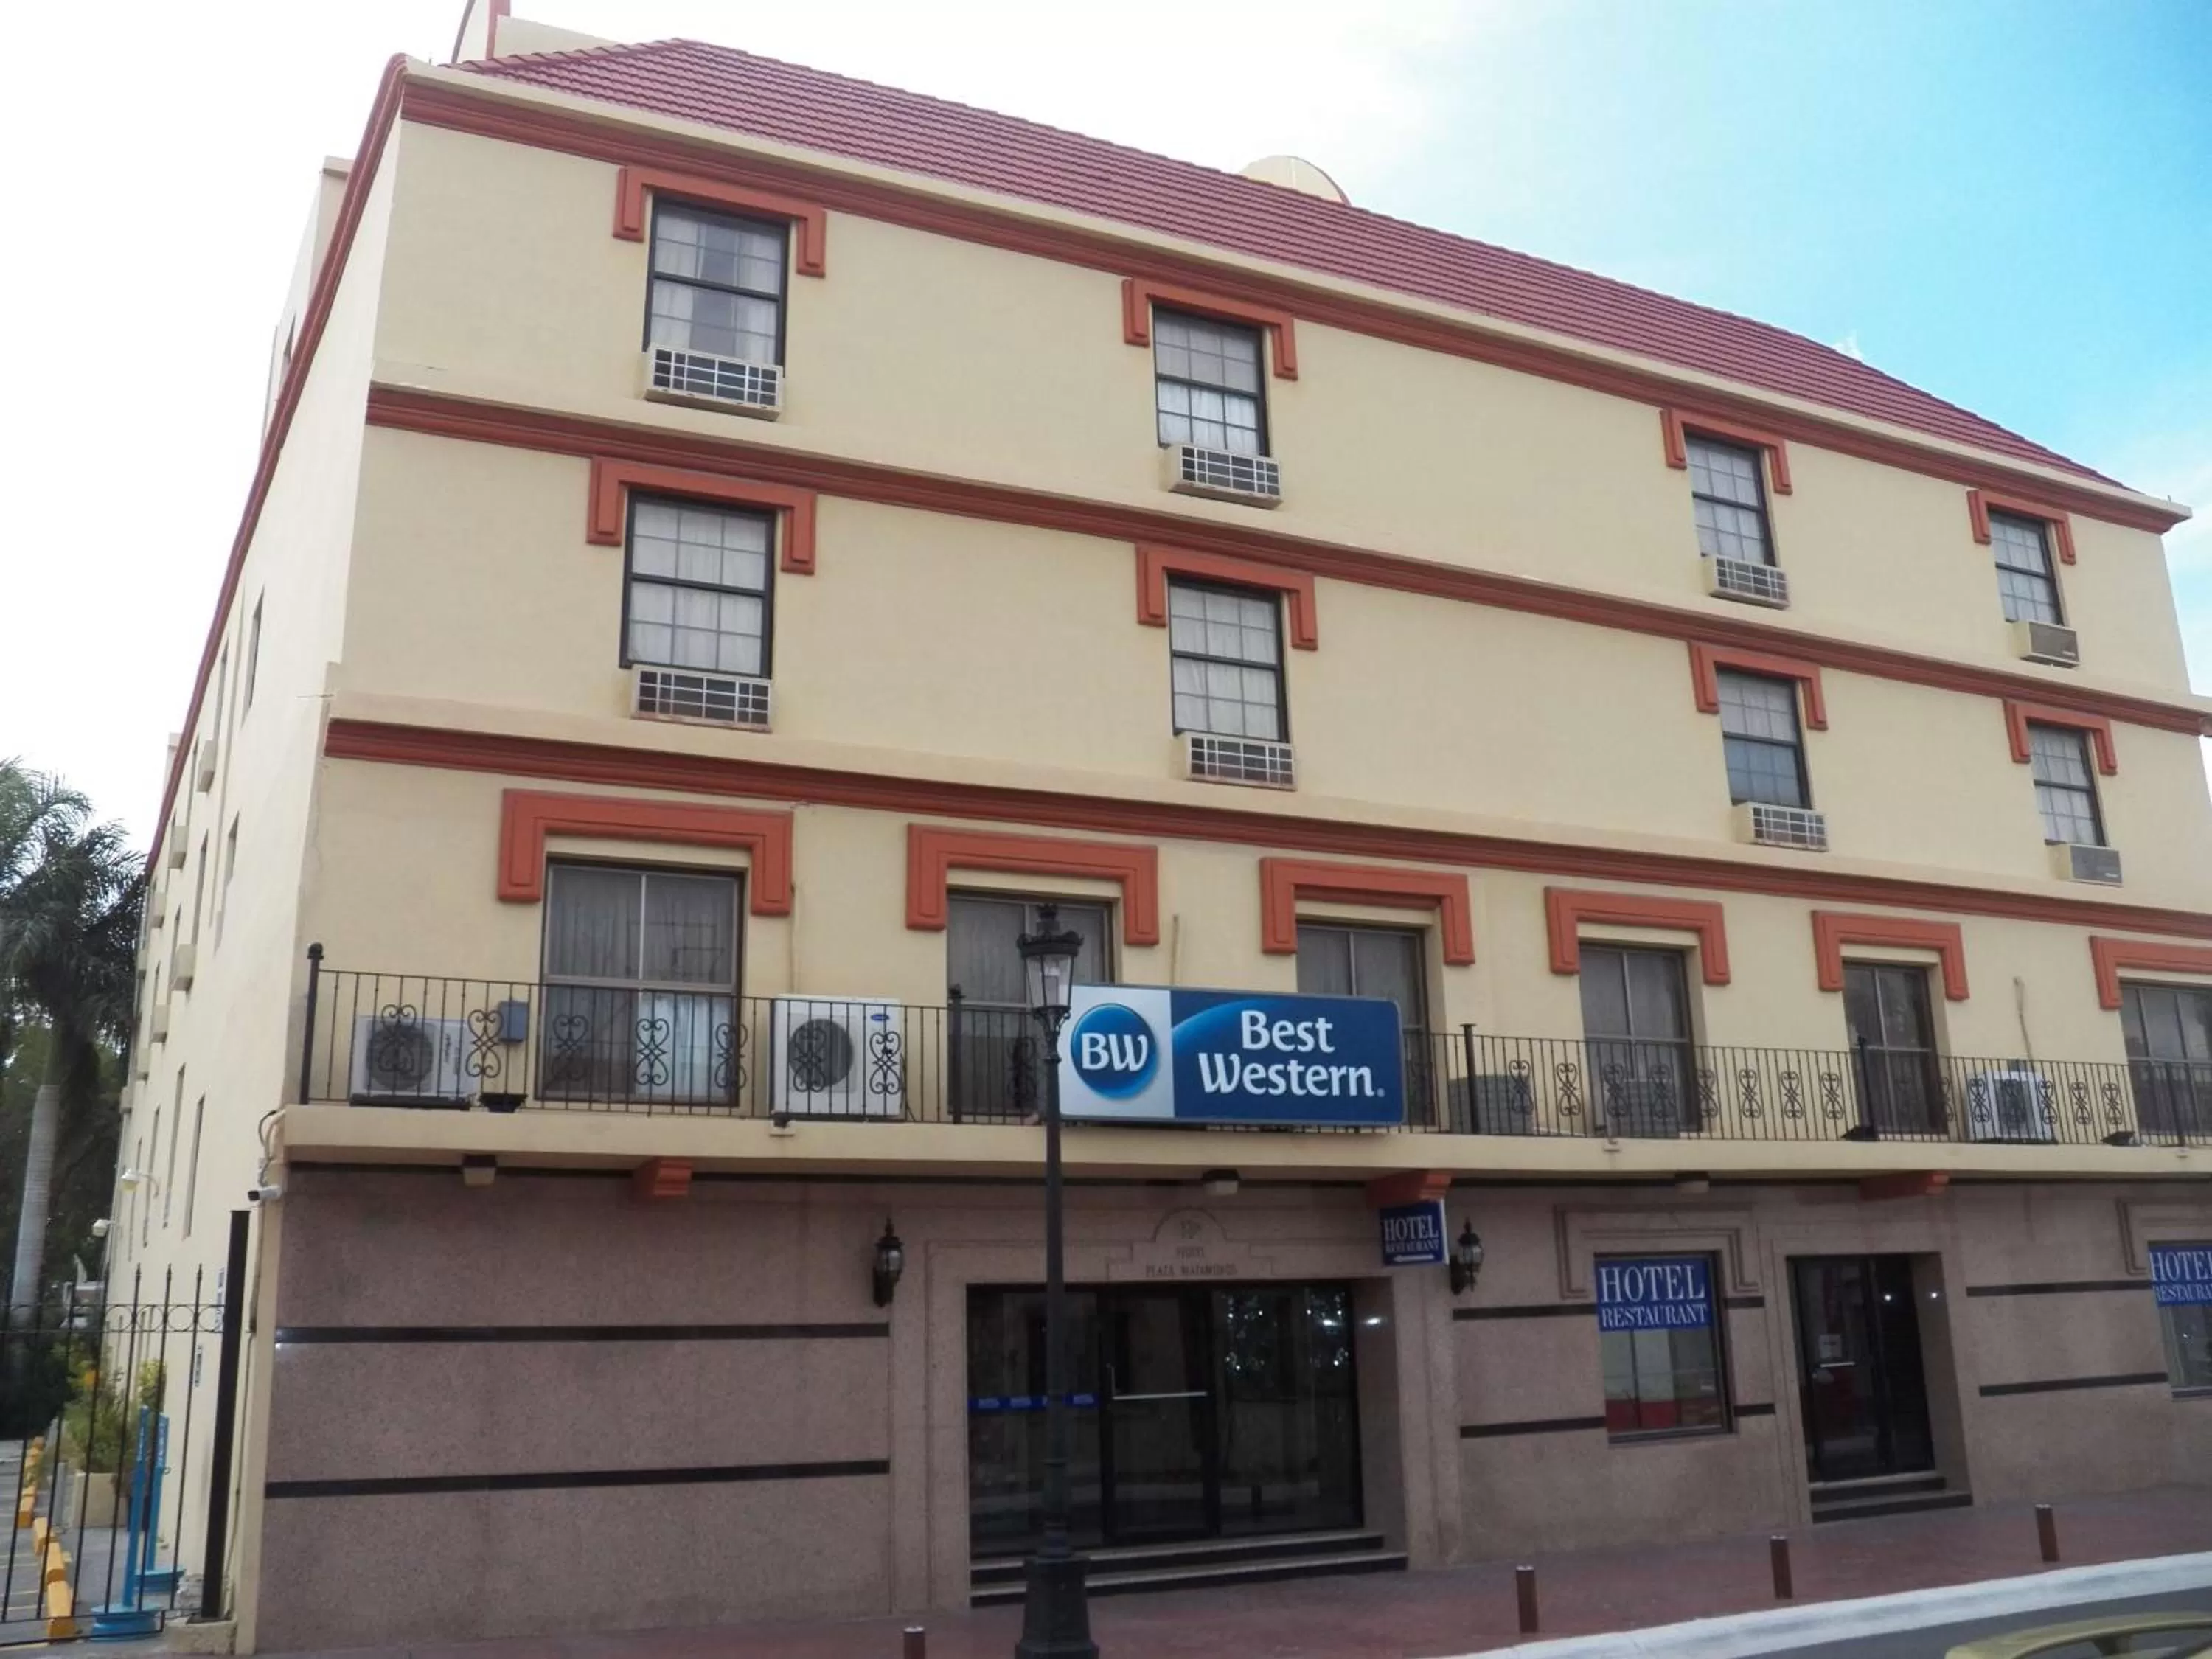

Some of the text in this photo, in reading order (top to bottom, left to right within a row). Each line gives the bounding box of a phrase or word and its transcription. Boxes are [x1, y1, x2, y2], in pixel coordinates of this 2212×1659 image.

[1241, 1010, 1335, 1052] Best
[1081, 1032, 1148, 1072] BW
[1384, 1215, 1439, 1241] HOTEL
[1599, 1265, 1705, 1303] HOTEL
[1601, 1303, 1707, 1327] RESTAURANT
